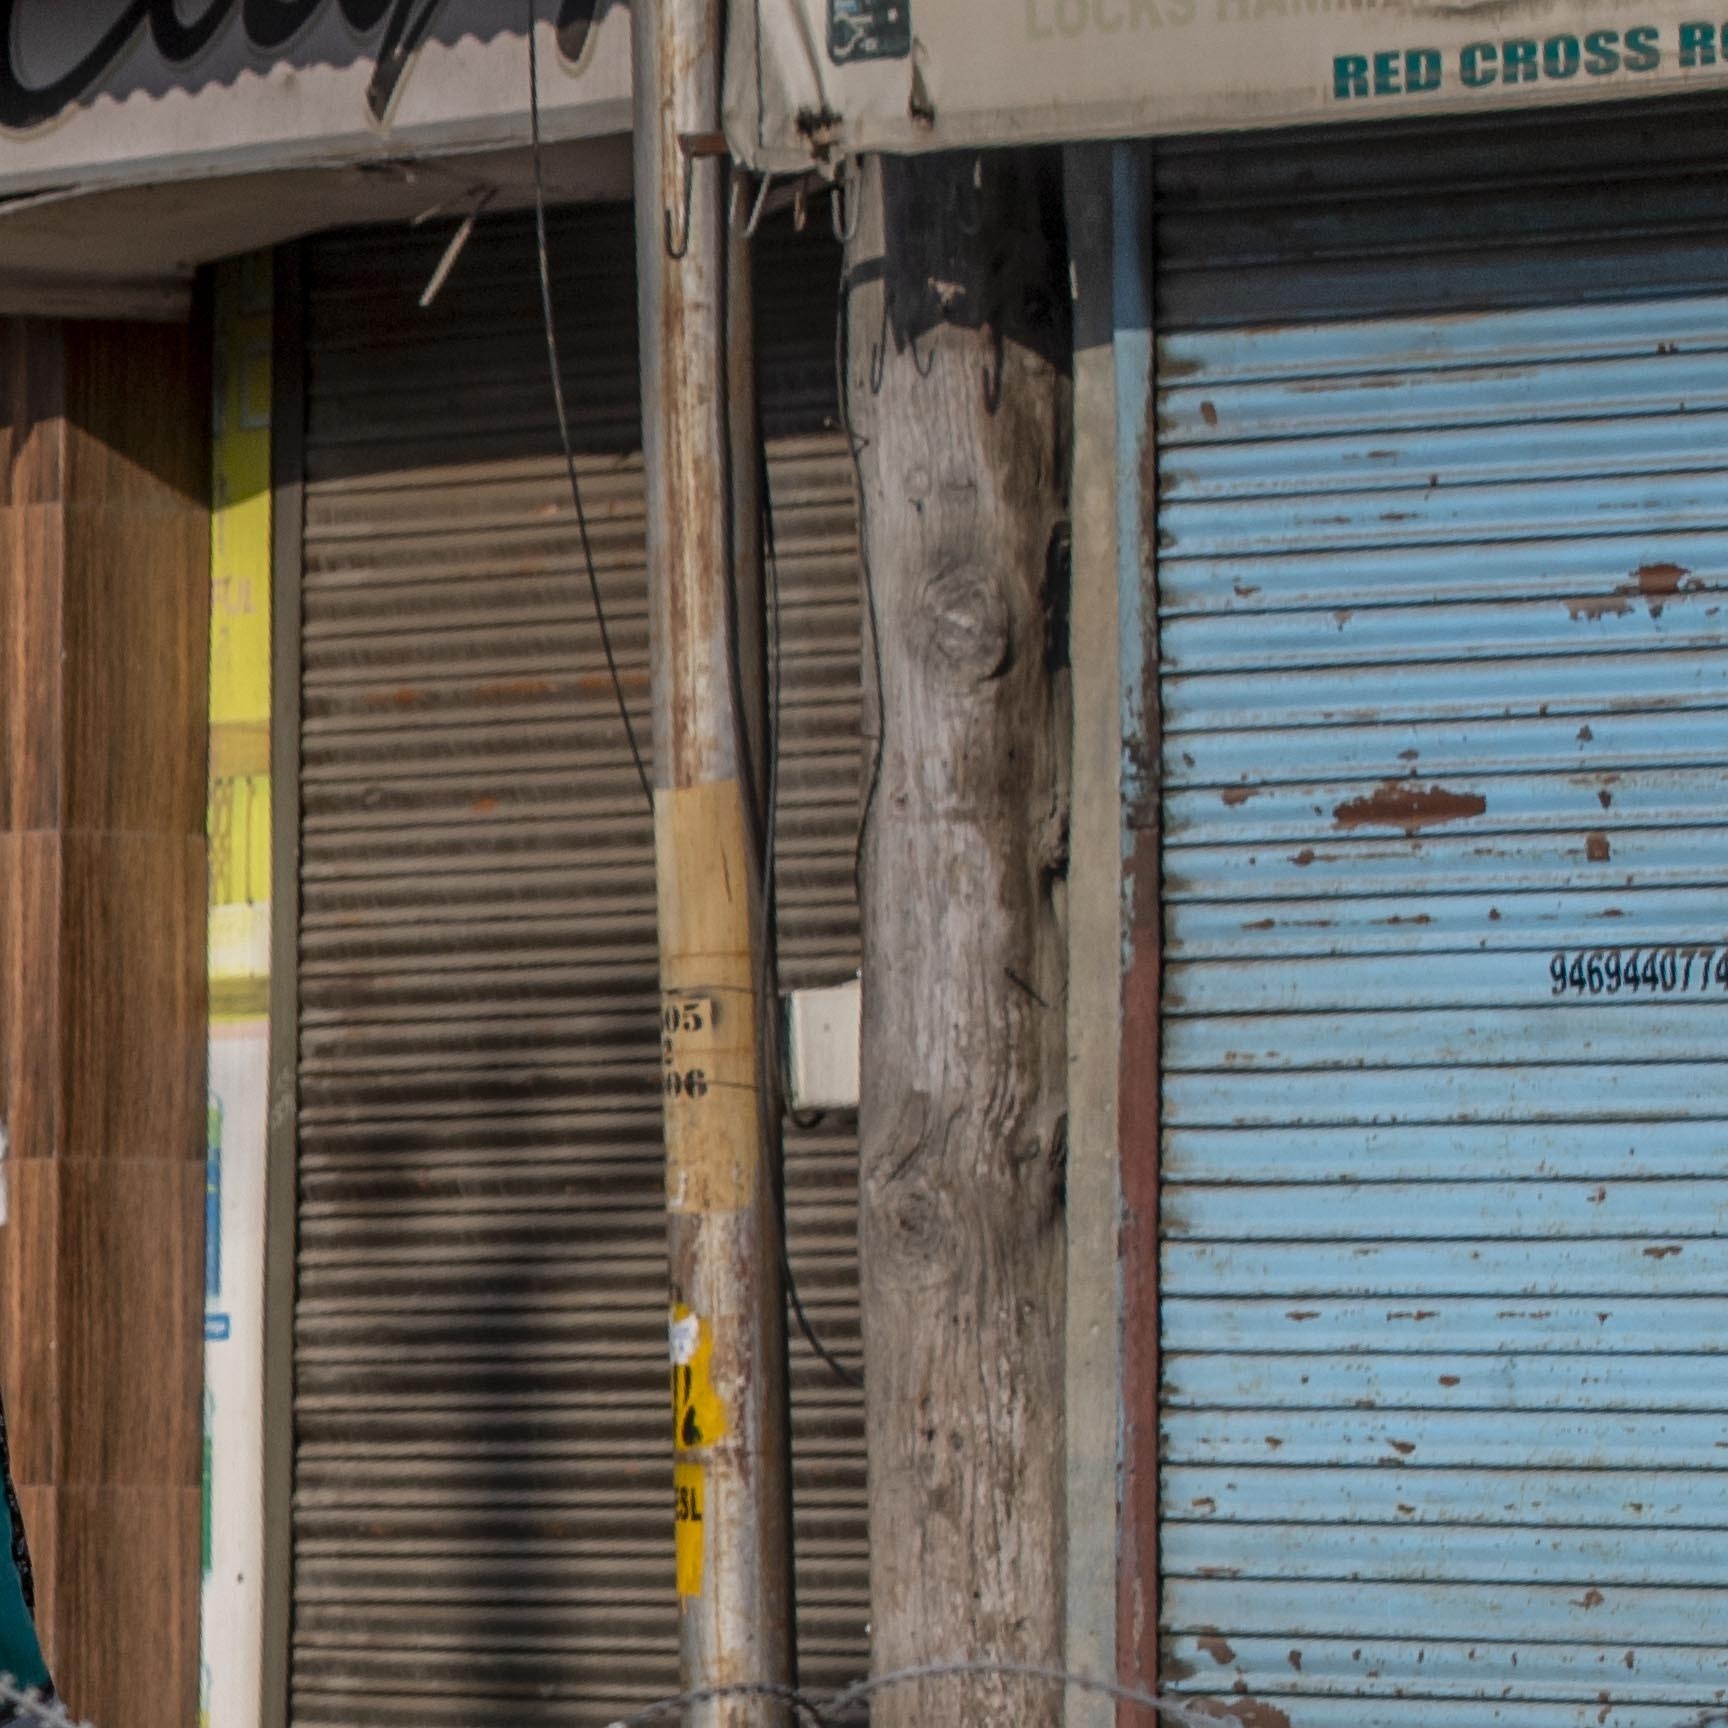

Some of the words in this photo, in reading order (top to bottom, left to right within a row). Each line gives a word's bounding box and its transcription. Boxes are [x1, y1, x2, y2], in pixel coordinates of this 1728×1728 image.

[1334, 49, 1443, 99] RED
[1458, 27, 1661, 88] CROSS
[1549, 947, 1728, 996] 9469440774
